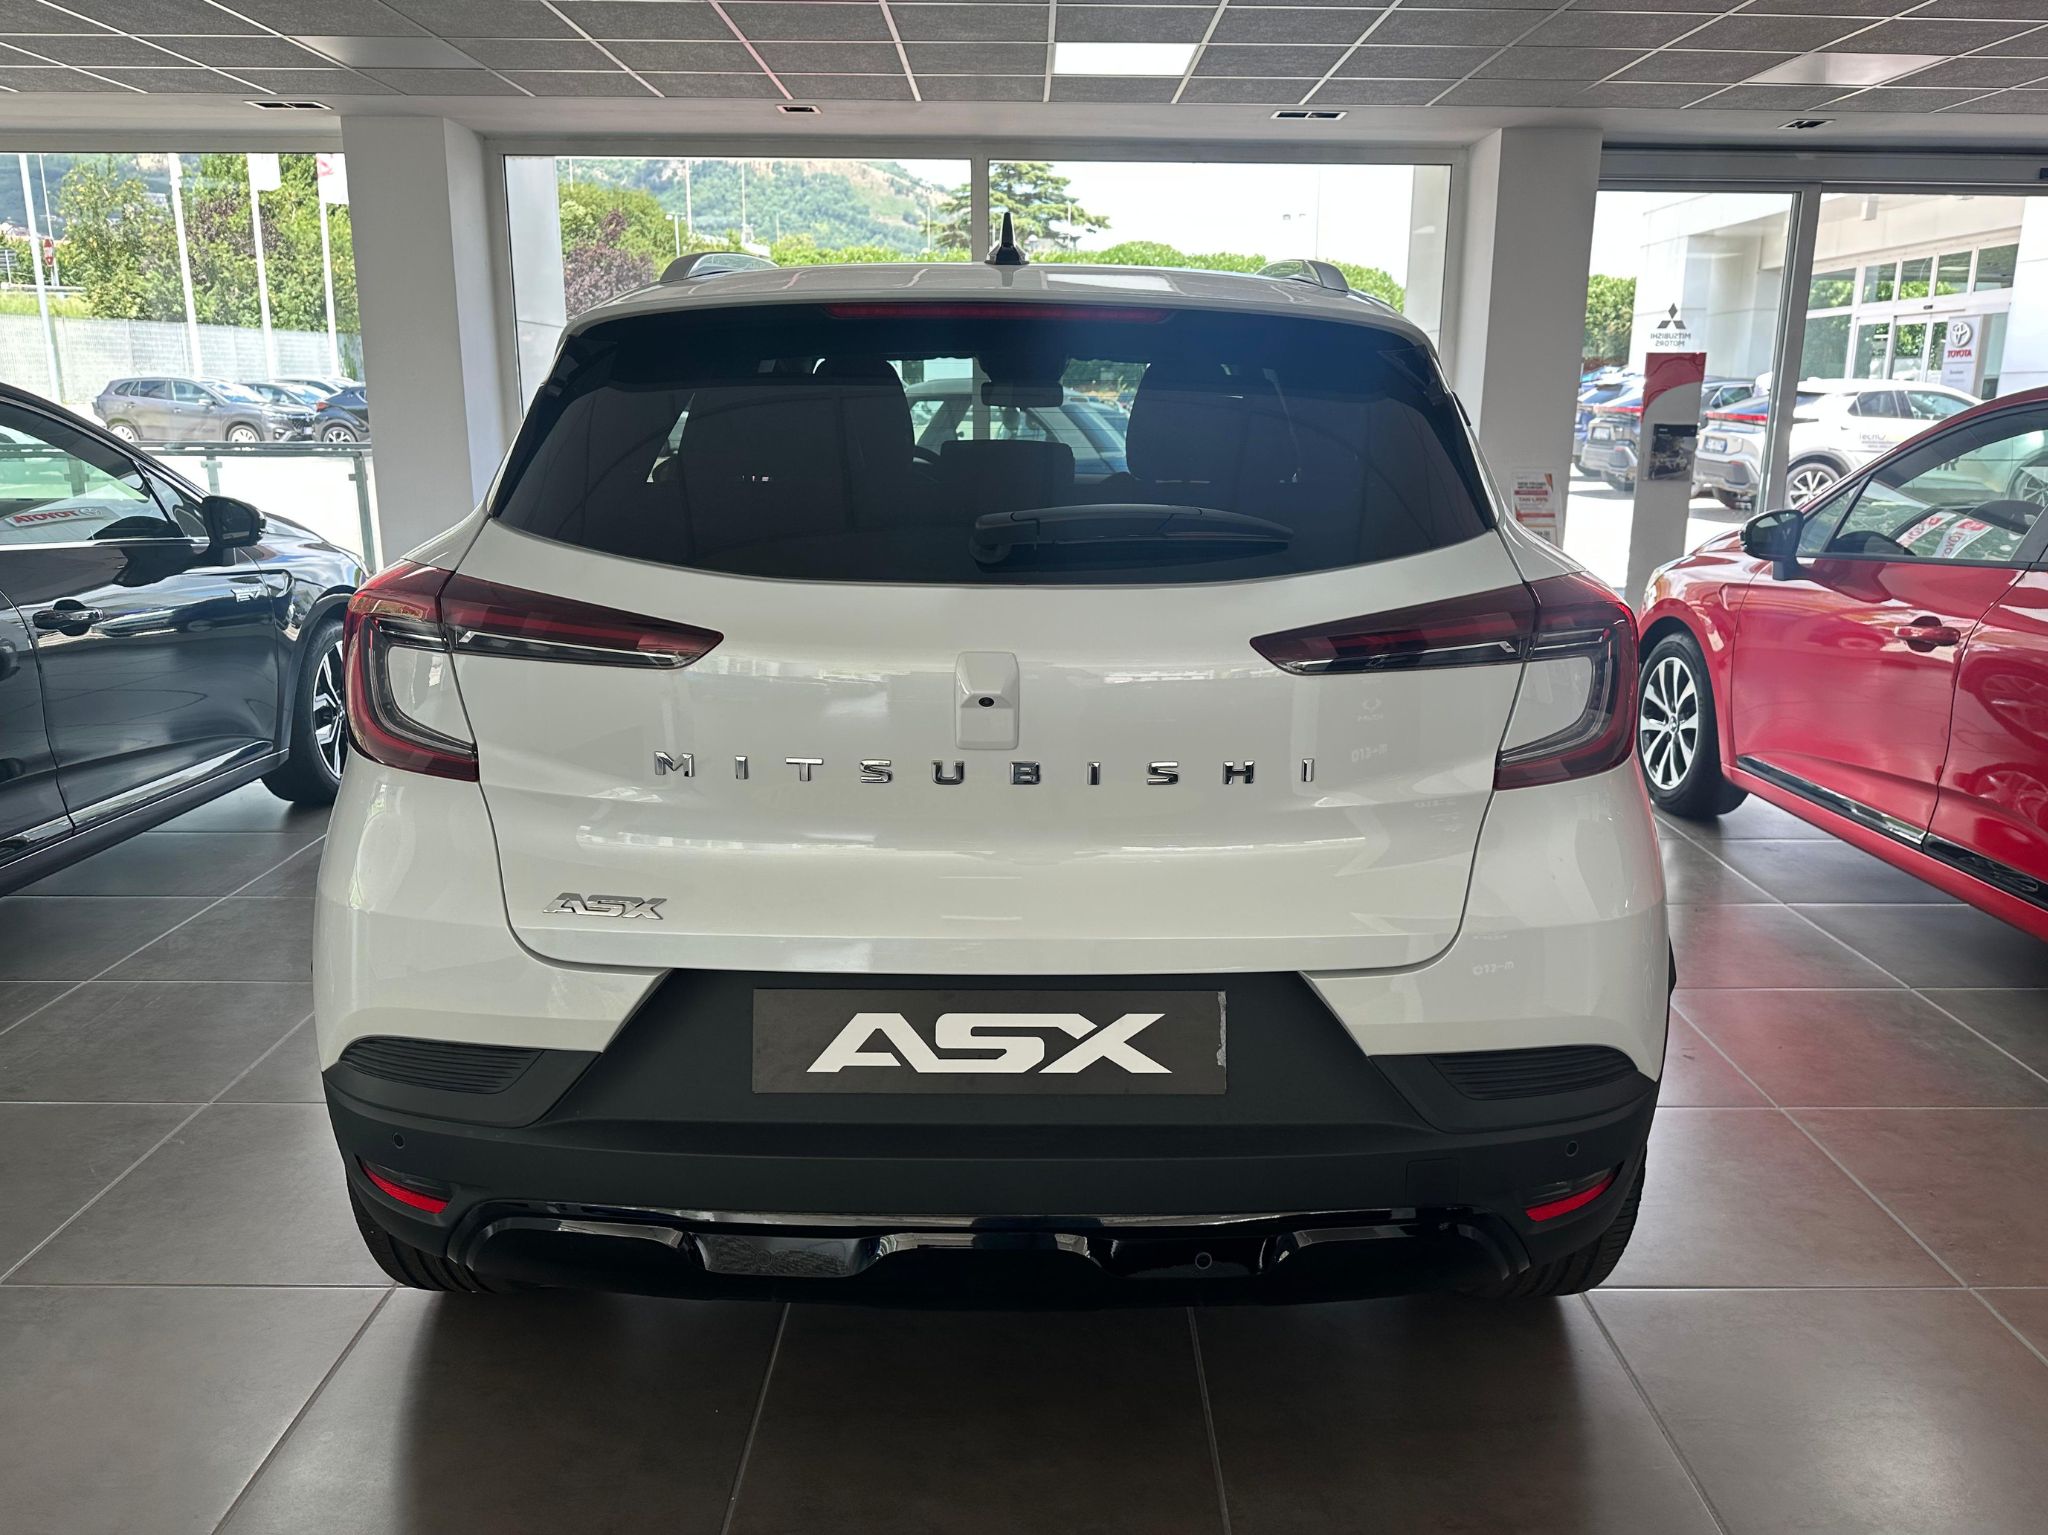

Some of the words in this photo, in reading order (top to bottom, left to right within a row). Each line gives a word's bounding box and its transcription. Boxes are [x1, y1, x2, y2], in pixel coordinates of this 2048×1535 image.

[1947, 349, 1972, 358] TOYOTA
[654, 751, 1315, 785] MITSUBISHI
[542, 892, 667, 920] ASX
[806, 1012, 1173, 1074] ASX
